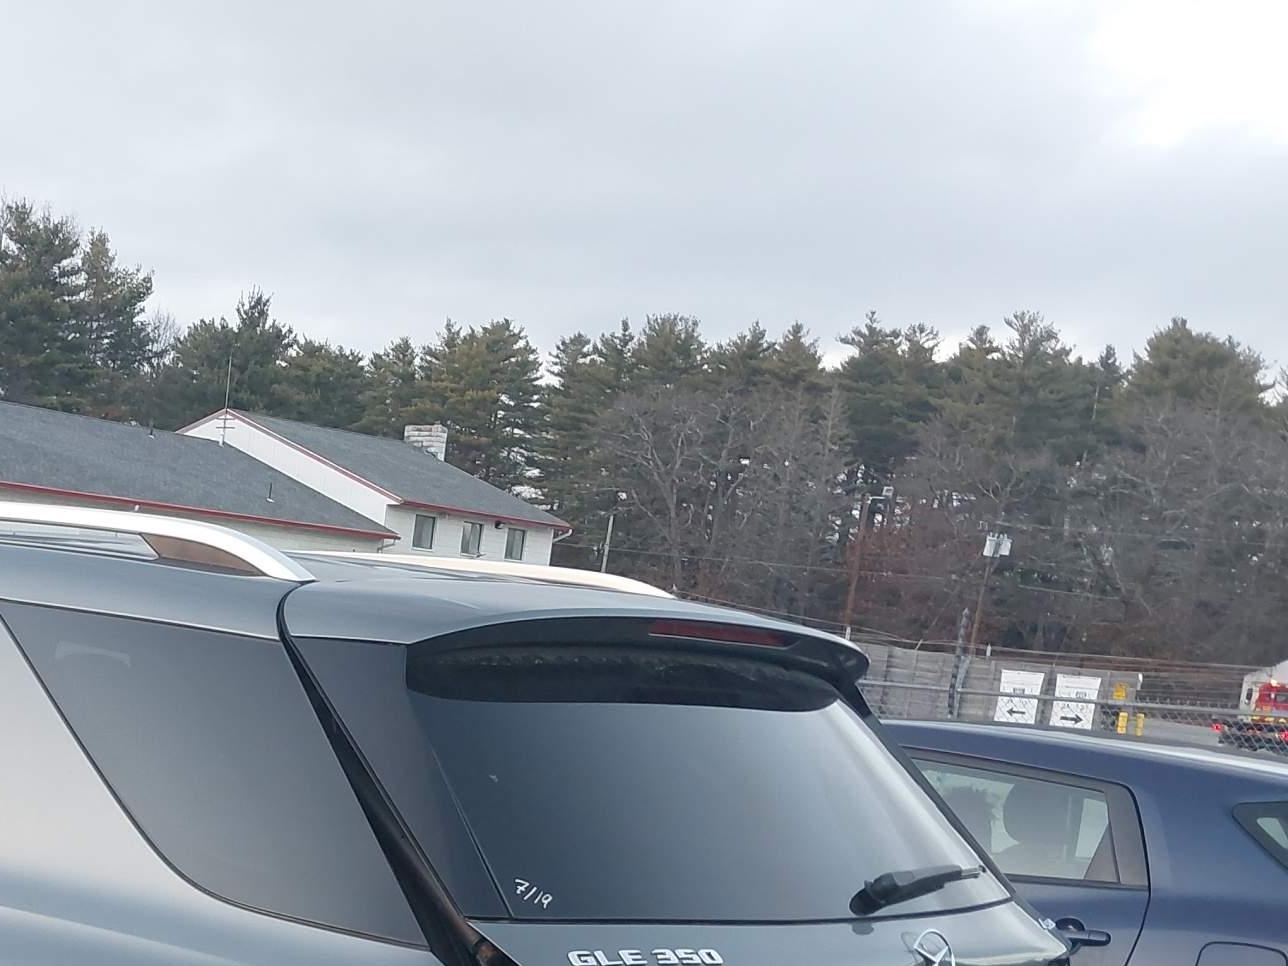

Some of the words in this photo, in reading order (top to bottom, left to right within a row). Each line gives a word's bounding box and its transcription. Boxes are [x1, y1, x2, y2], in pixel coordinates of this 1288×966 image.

[514, 878, 553, 909] 7/19
[567, 949, 648, 966] GLE
[651, 948, 724, 966] 350
